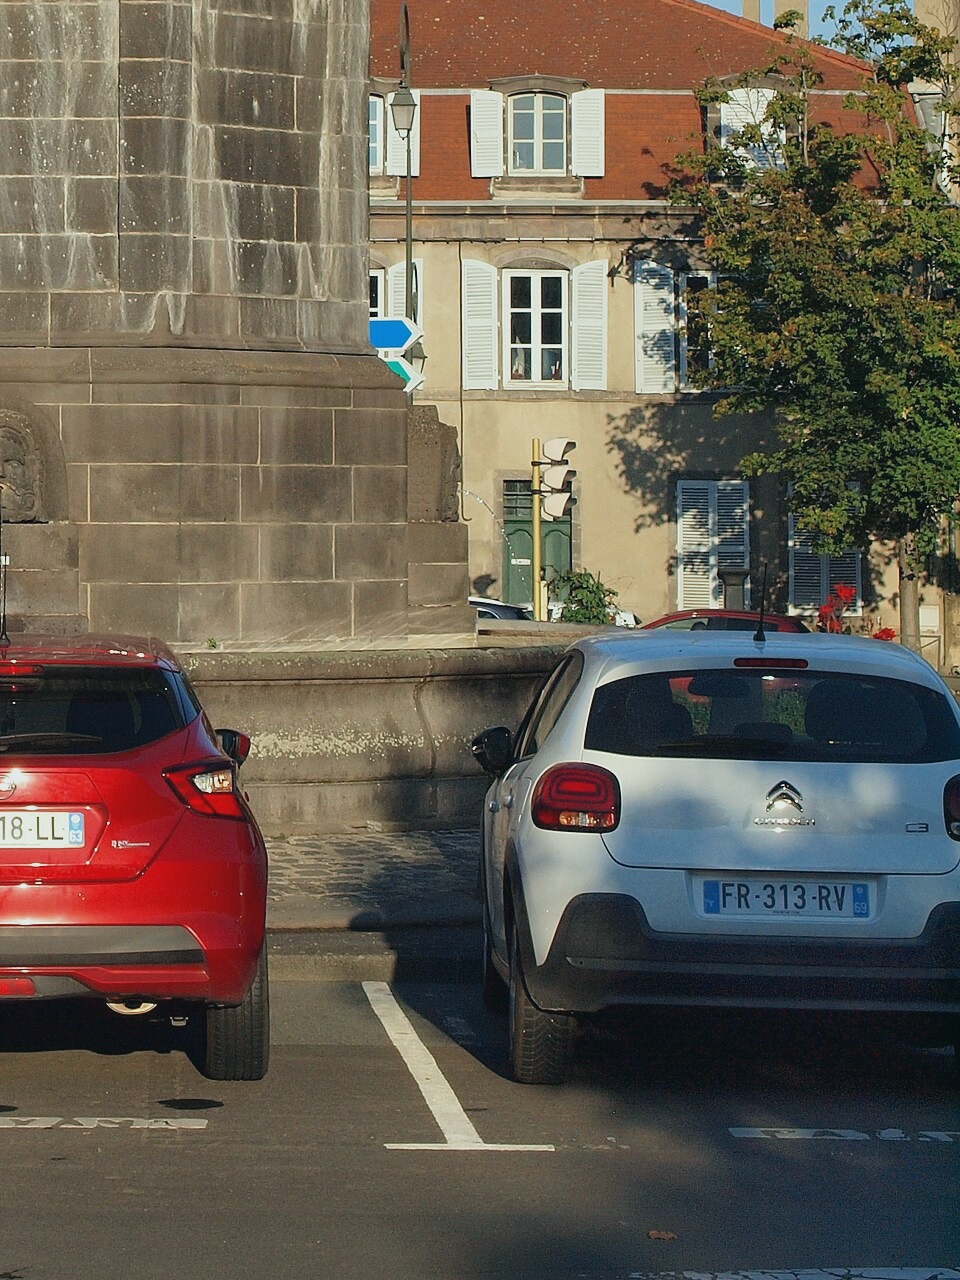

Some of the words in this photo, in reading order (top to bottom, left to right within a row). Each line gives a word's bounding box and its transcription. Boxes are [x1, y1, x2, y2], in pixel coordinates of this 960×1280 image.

[904, 822, 929, 833] C3
[69, 829, 83, 843] 63
[721, 882, 846, 912] FR-313-RV
[854, 902, 868, 914] 69
